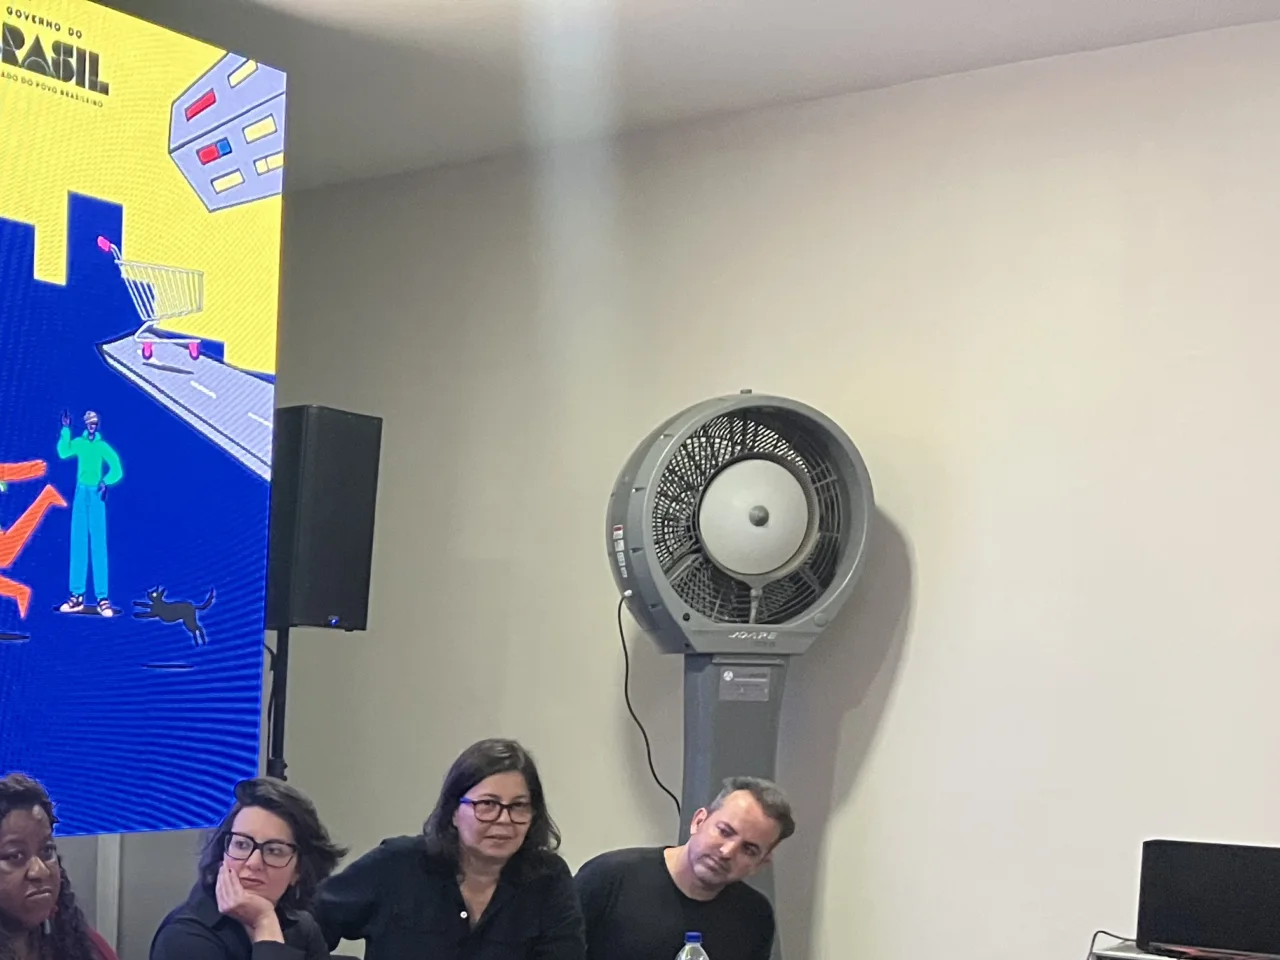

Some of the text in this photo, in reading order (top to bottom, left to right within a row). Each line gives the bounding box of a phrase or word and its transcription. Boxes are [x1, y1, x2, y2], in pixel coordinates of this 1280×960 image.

[6, 6, 83, 39] GOVERNO DO
[20, 77, 34, 87] DO
[35, 81, 58, 94] POVO
